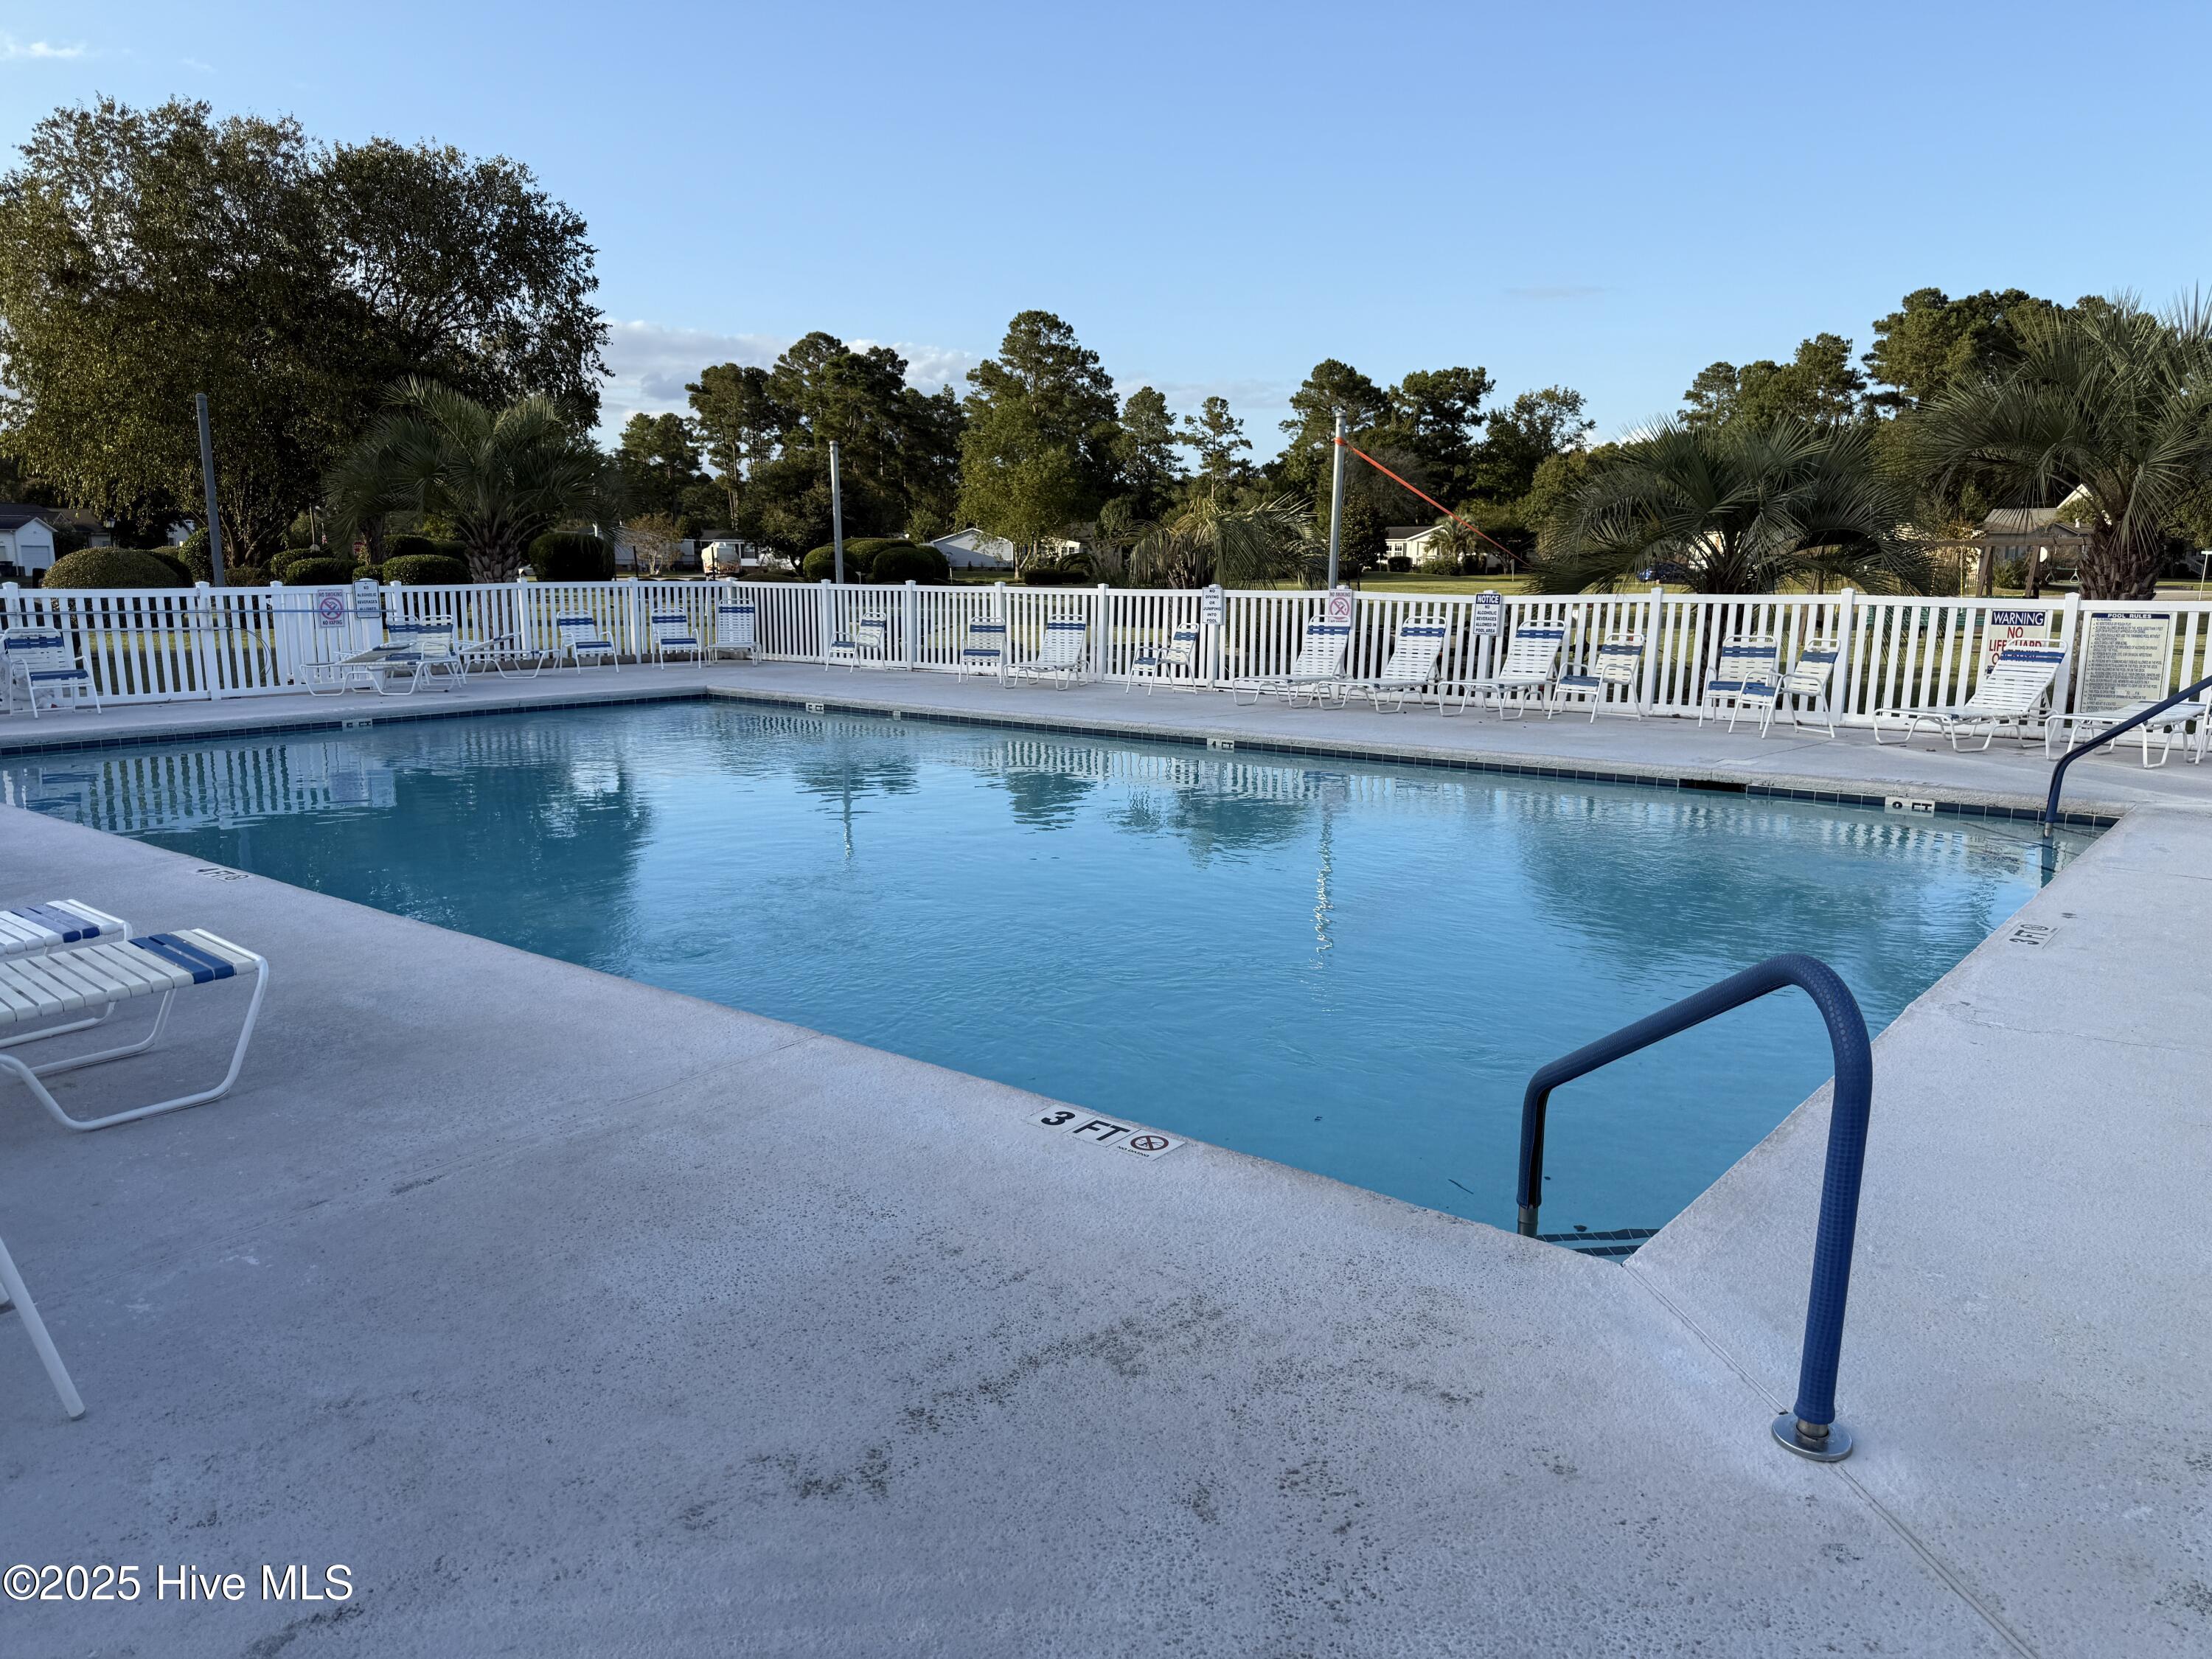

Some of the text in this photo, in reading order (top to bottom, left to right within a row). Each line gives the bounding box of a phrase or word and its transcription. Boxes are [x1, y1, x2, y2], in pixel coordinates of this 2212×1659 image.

[1477, 595, 1500, 604] NOTICE
[1993, 611, 2044, 625] WARNING
[2007, 626, 2024, 639] NO
[2014, 929, 2048, 940] FT
[1040, 1110, 1131, 1141] 3 FT
[1127, 1149, 1150, 1158] DIVING
